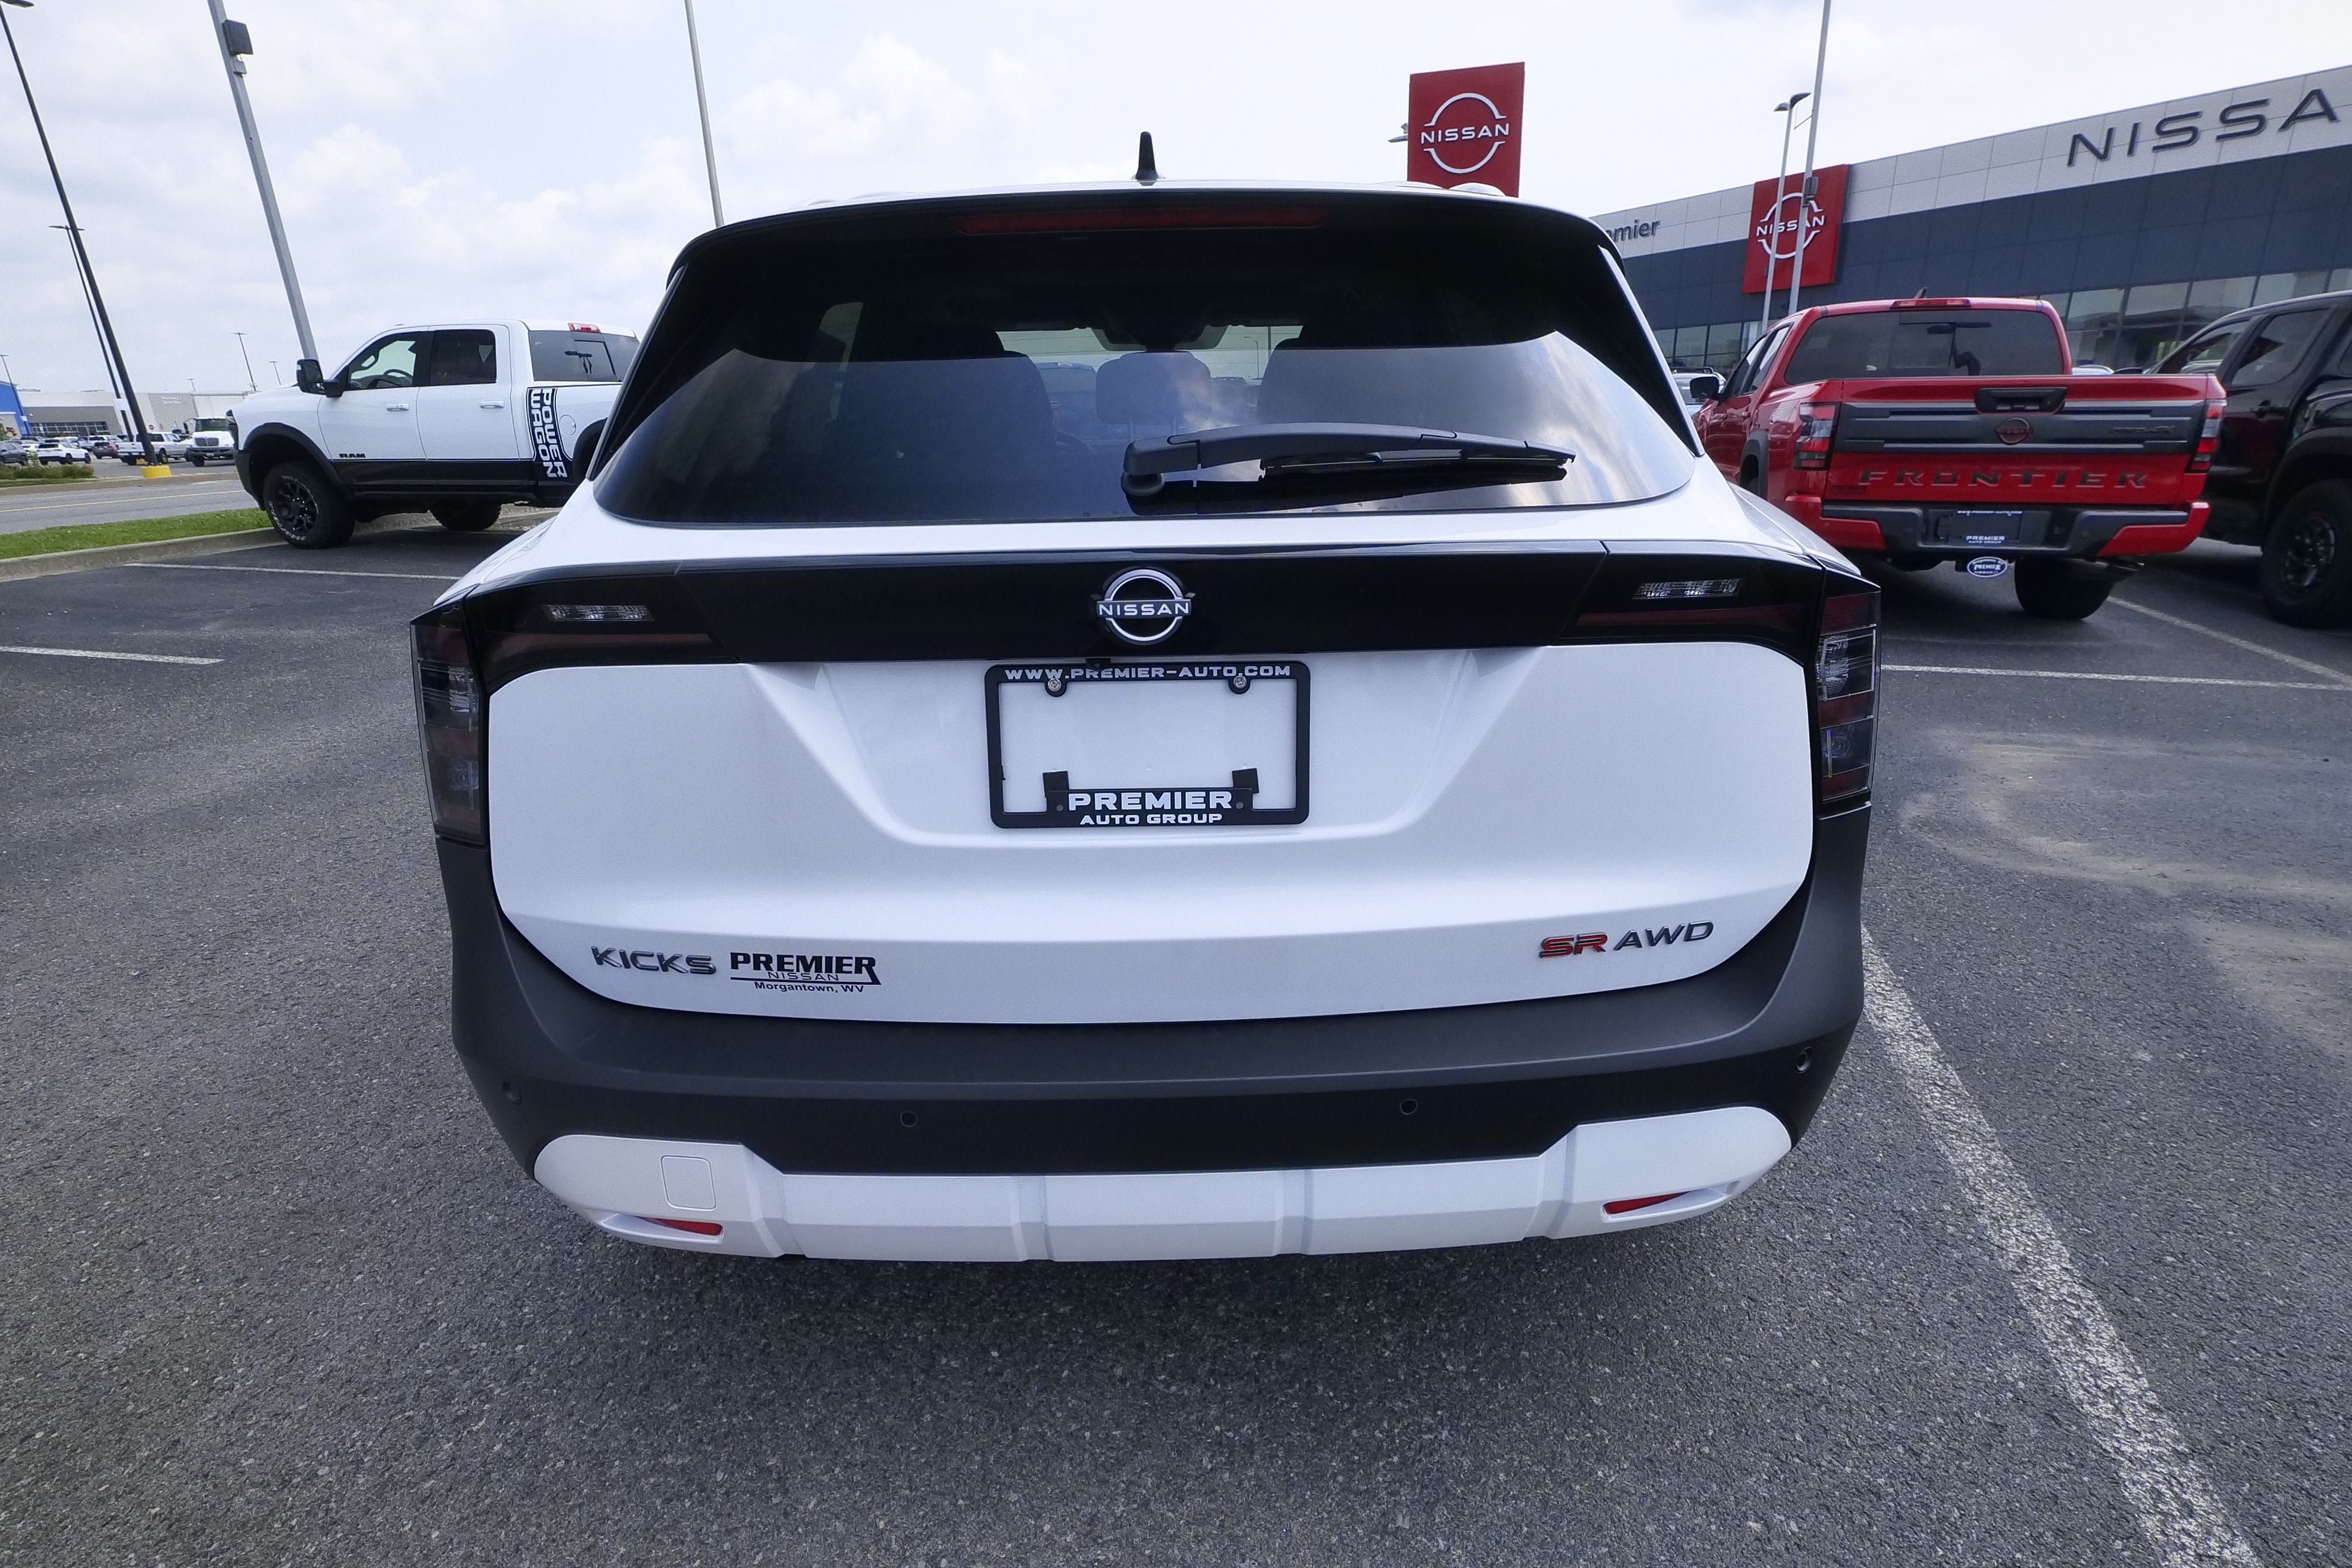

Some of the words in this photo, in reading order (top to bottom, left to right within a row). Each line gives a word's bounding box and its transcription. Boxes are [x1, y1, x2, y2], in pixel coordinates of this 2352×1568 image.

[1421, 123, 1509, 144] NISSAN
[2067, 89, 2340, 167] NISSA
[531, 389, 558, 478] WAGON
[542, 388, 567, 478] POWER
[1858, 469, 2147, 488] FRONTIER
[1098, 602, 1190, 616] NISSAN
[1005, 665, 1291, 680] WWW.PREMIER-AUTO.COM
[1068, 790, 1232, 811] PREMIER
[1080, 814, 1140, 825] AUTO
[1146, 813, 1223, 824] GROUP
[1538, 932, 1608, 959] SR
[1613, 919, 1714, 951] AWD
[590, 945, 717, 975] KICKS
[730, 952, 881, 985] PREMIER
[767, 971, 839, 981] NISSAN
[754, 981, 838, 994] Morgantown,
[841, 985, 864, 993] WV
